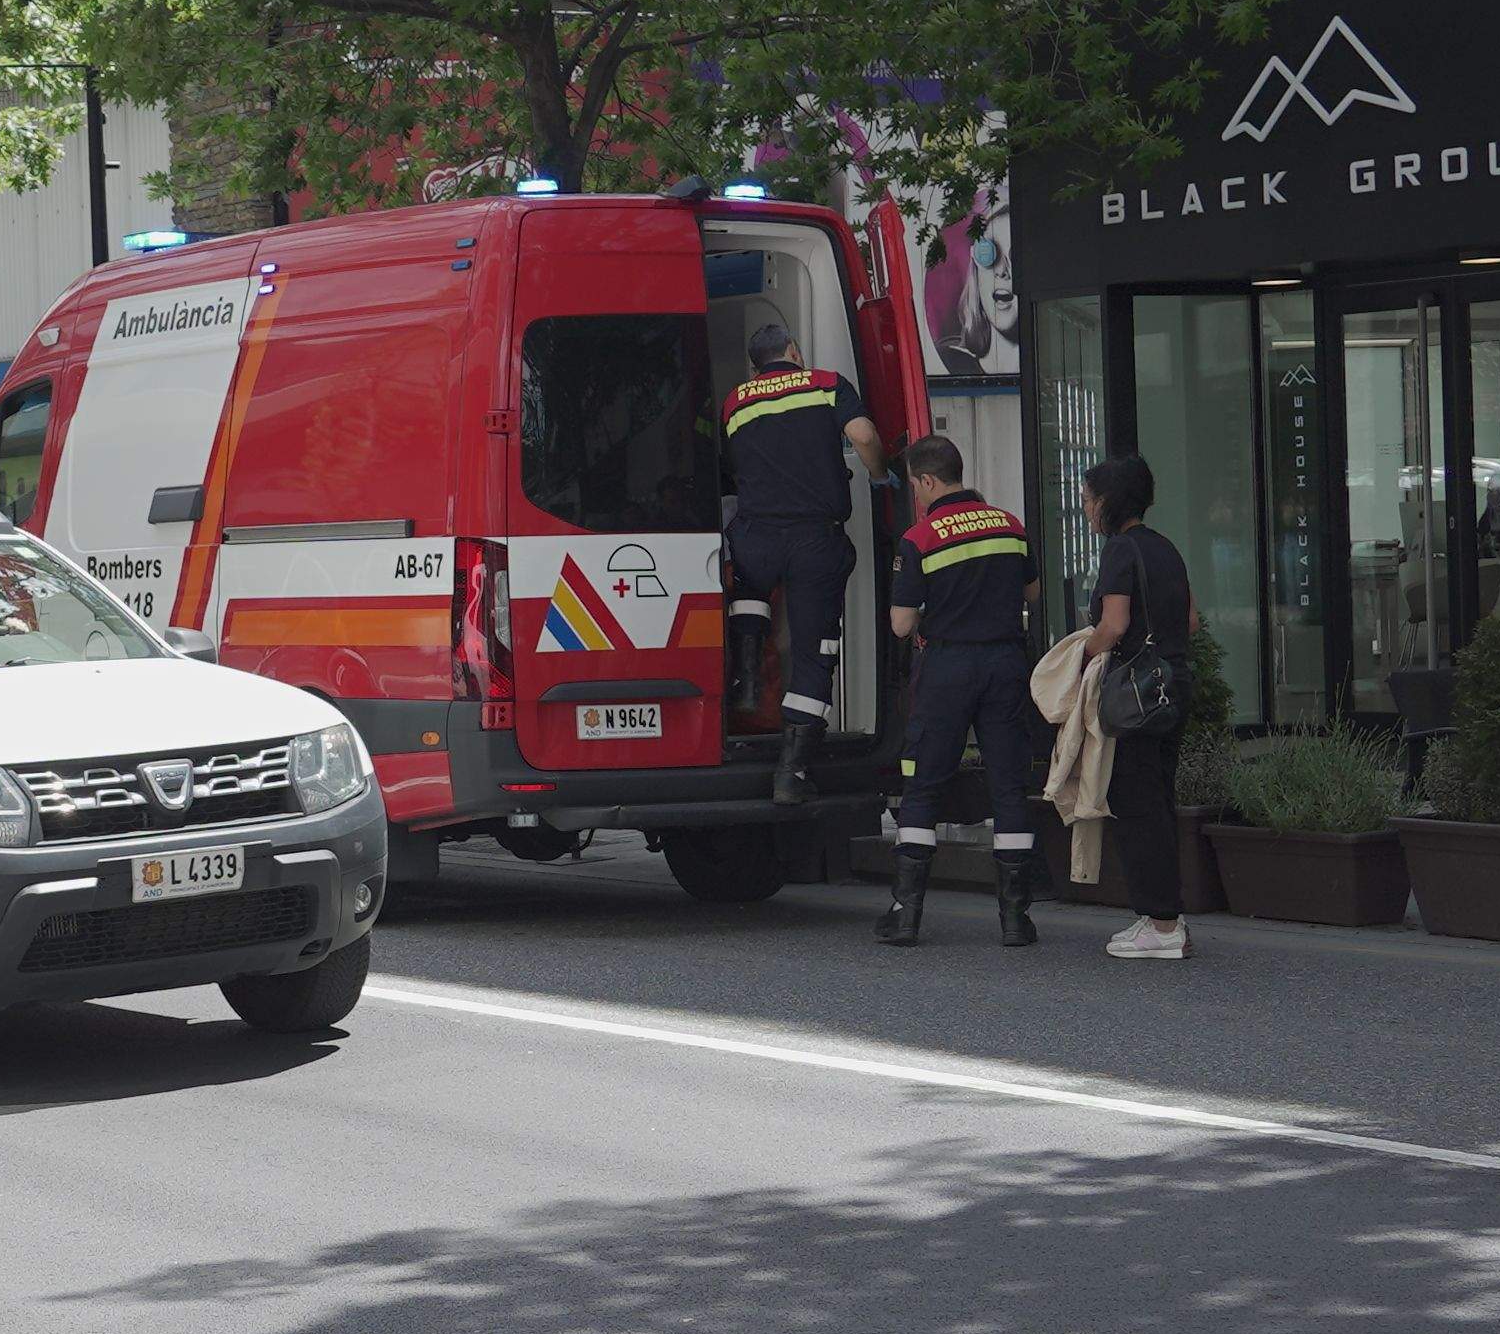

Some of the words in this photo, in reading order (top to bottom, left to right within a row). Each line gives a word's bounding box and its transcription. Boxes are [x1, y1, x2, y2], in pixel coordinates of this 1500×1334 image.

[1102, 171, 1289, 225] BLACK
[112, 296, 234, 340] Ambulància
[737, 370, 813, 391] BOMBERS
[737, 377, 811, 401] D'ANDORRA
[1293, 395, 1306, 487] HOUSE
[931, 510, 1007, 531] BOMBERS
[937, 517, 1011, 540] D'ANDORRA
[87, 553, 162, 580] Bombers
[394, 553, 444, 579] AB-67
[1298, 515, 1310, 606] BLACK
[123, 592, 154, 618] 118
[619, 708, 657, 728] 9642
[171, 859, 182, 885] L
[188, 852, 237, 882] 4339
[142, 887, 163, 898] AND
